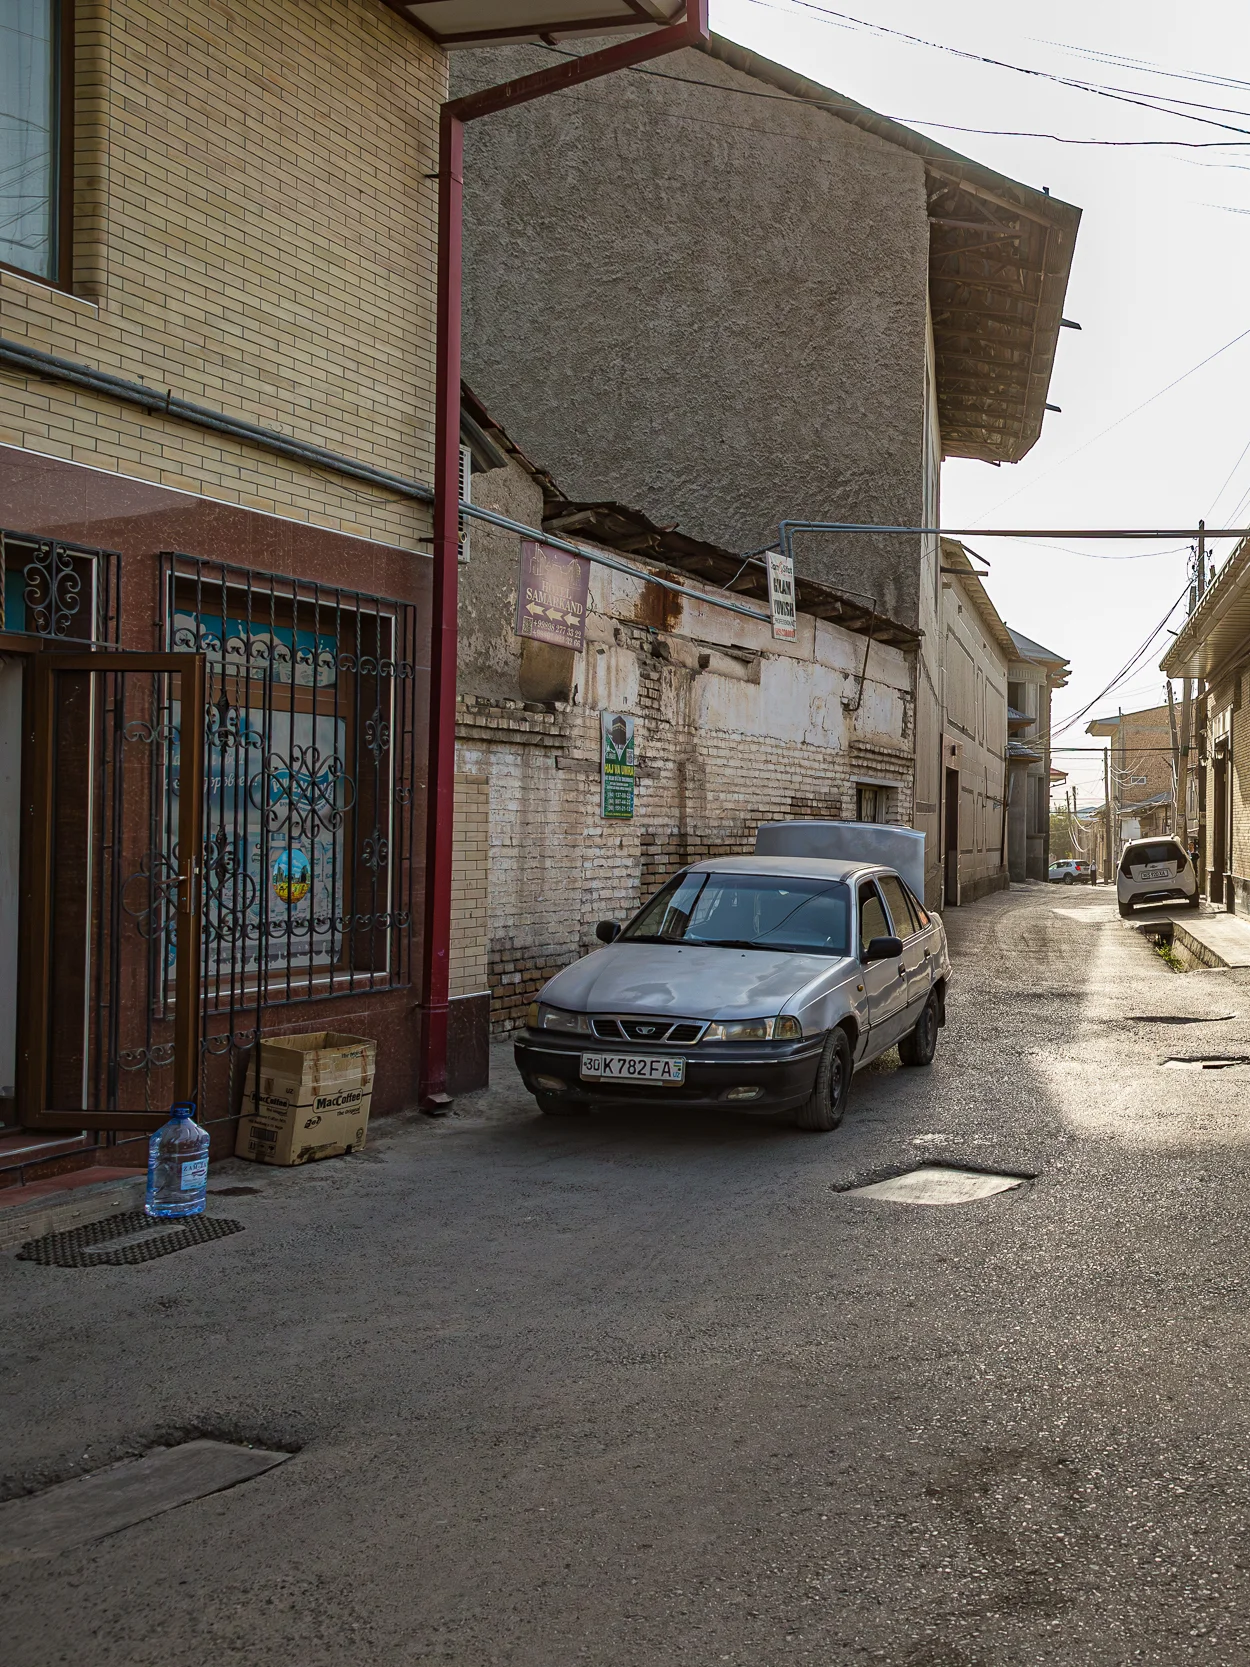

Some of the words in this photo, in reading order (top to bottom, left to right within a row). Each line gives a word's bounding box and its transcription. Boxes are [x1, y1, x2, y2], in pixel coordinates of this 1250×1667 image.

[542, 580, 571, 599] HOTEL
[526, 587, 583, 615] SAMARKAND
[555, 623, 567, 635] 277
[574, 630, 582, 639] 22
[604, 763, 614, 774] HAJ
[586, 1057, 600, 1071] 30
[285, 1087, 294, 1095] UZ
[316, 1091, 361, 1110] MacCoffee
